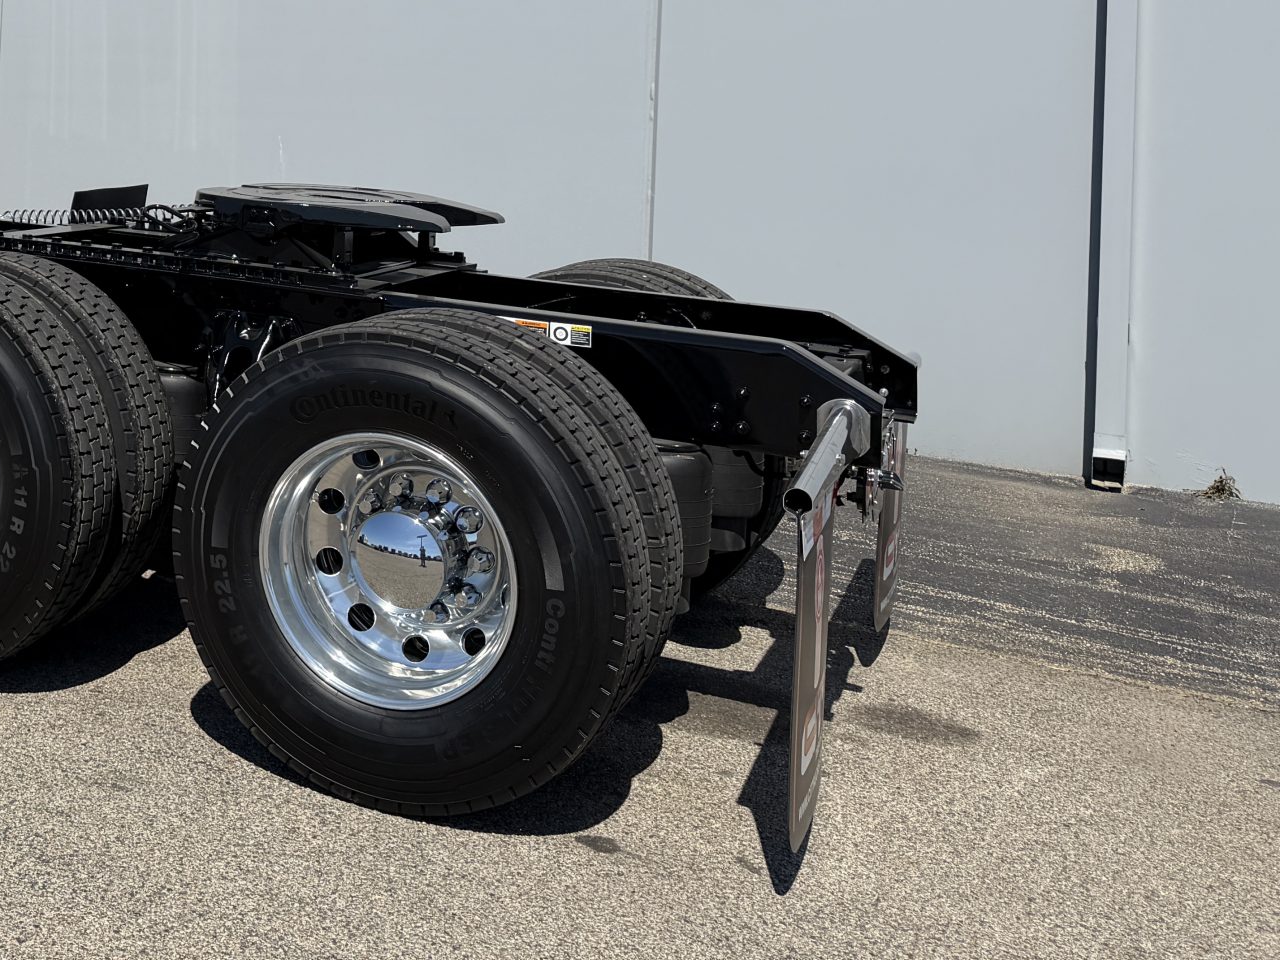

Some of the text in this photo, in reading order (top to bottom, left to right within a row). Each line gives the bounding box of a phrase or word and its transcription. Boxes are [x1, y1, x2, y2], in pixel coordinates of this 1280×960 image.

[289, 382, 438, 423] Continental
[14, 485, 28, 509] 11
[9, 515, 25, 536] R
[209, 553, 238, 614] 22.5
[534, 597, 567, 675] Conti
